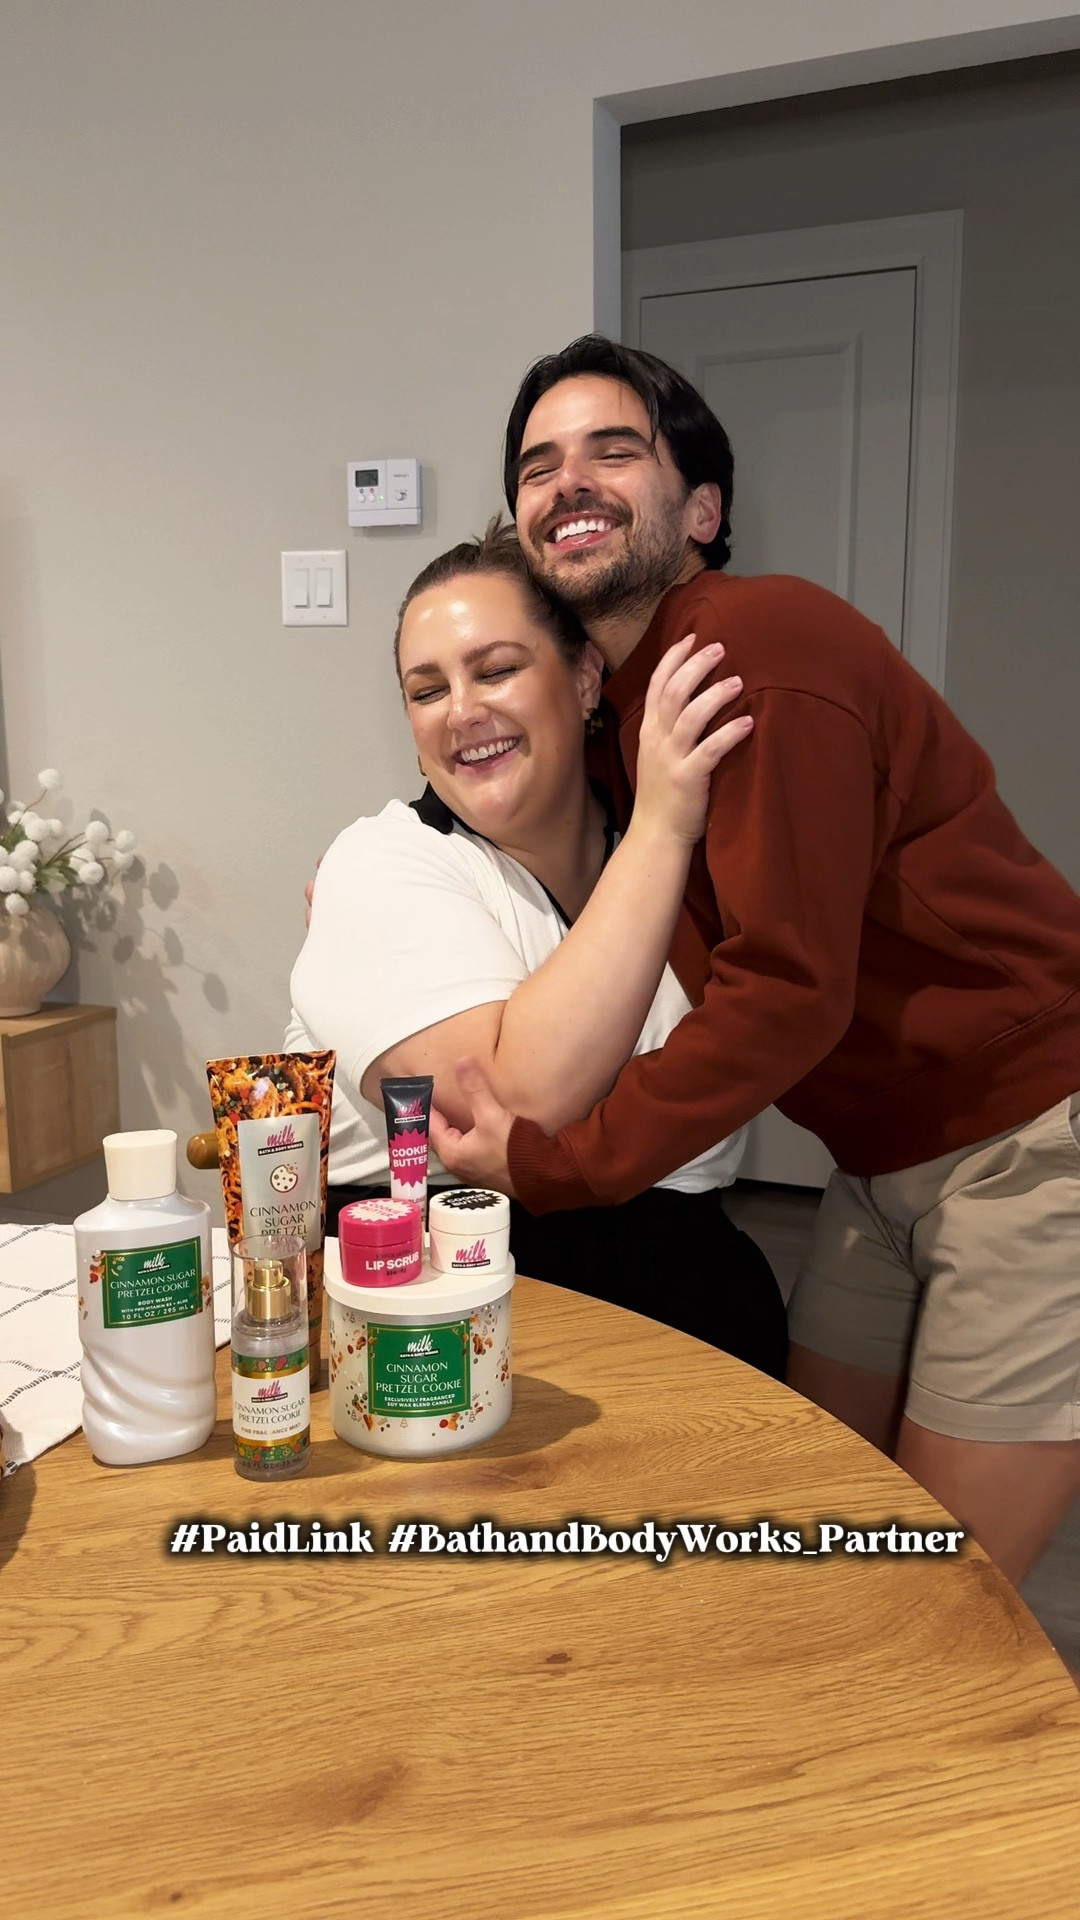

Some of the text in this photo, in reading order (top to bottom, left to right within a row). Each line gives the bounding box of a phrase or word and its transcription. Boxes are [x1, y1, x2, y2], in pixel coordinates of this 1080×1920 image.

[398, 1098, 424, 1118] milk
[267, 1123, 296, 1147] milk
[392, 1144, 427, 1157] COOKIE
[250, 1200, 316, 1217] CINNAMON
[265, 1213, 305, 1228] SUGAR
[456, 1238, 486, 1262] milk
[143, 1252, 165, 1269] milk
[365, 1251, 419, 1270] LIP SCRUB
[110, 1269, 196, 1289] CINNAMON SUGAR
[117, 1280, 190, 1299] PRETZEL COOKIE
[163, 1306, 176, 1314] 295
[407, 1333, 434, 1353] milk
[386, 1361, 448, 1373] CINNAMON
[376, 1379, 462, 1394] PRETZEL COOKIE
[400, 1373, 438, 1384] SUGAR
[258, 1380, 281, 1397] milk
[419, 1393, 456, 1402] FRAGRANCED
[235, 1401, 280, 1415] CINNAMON
[239, 1409, 301, 1425] PRETZEL COOKIE
